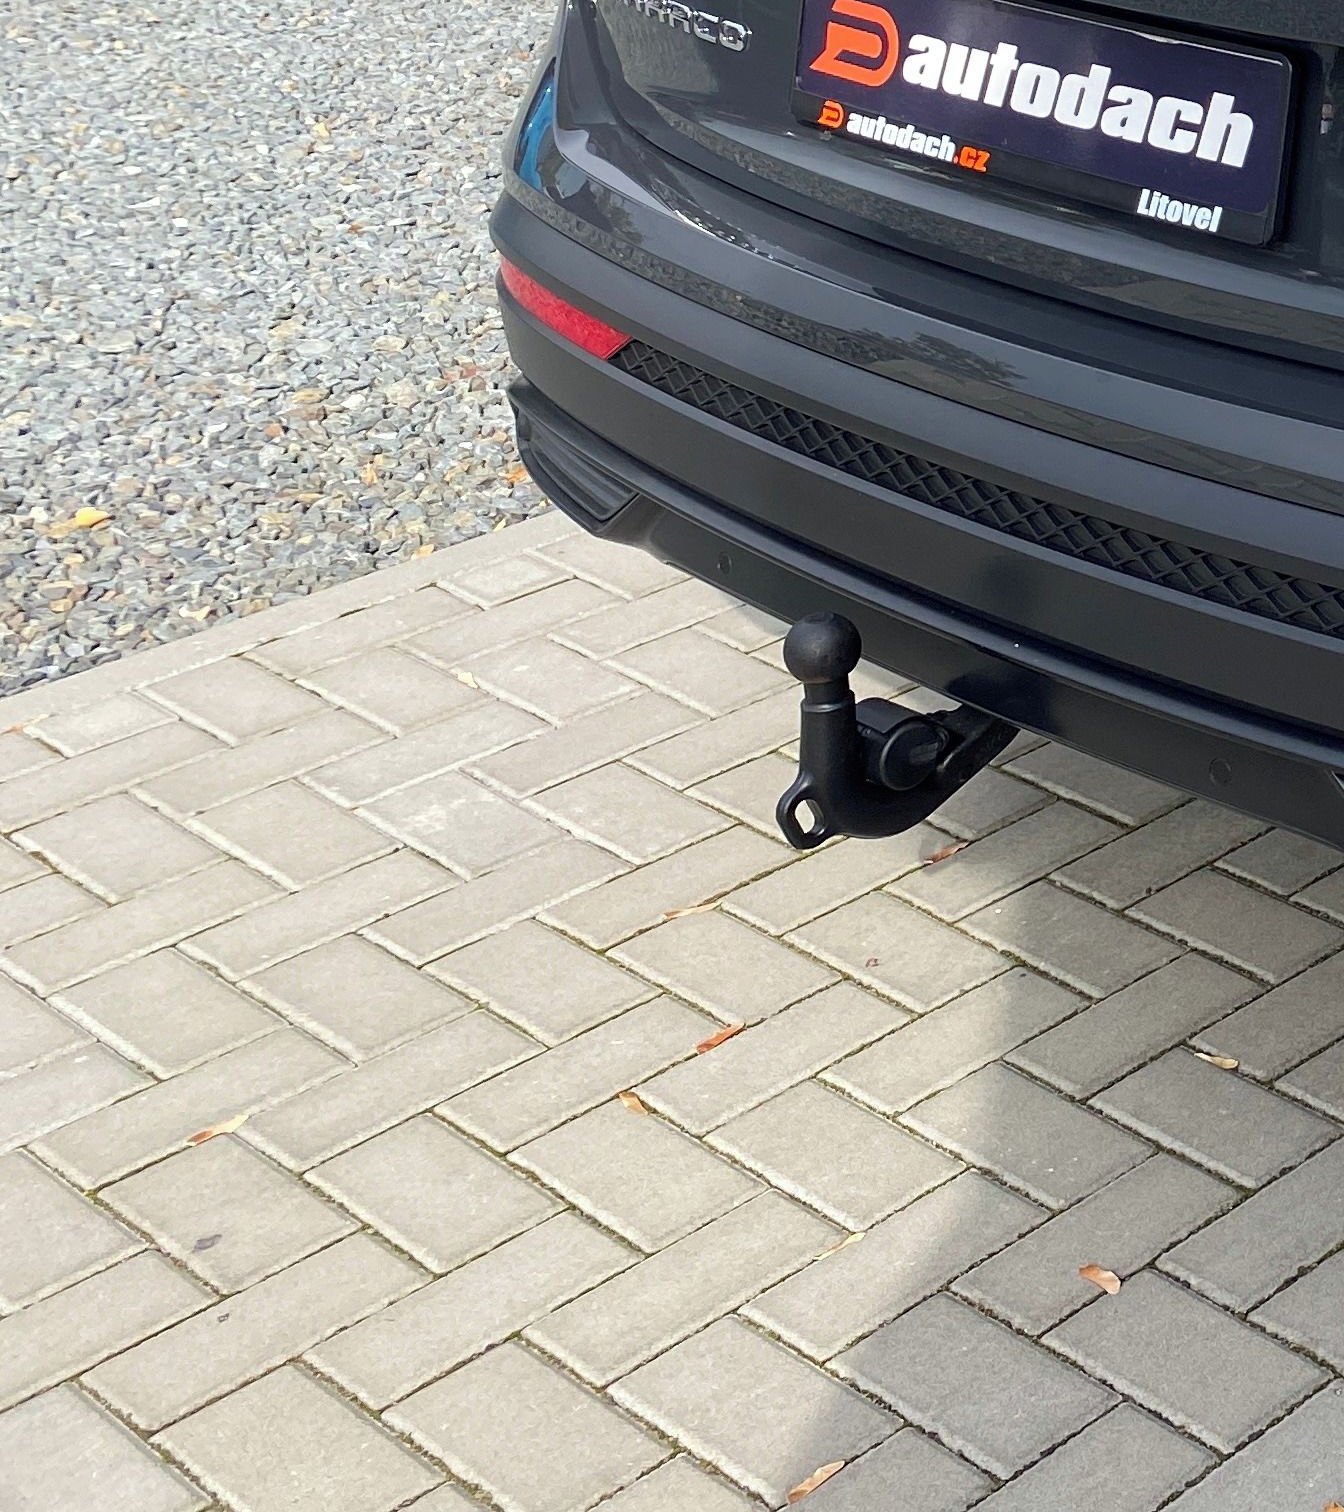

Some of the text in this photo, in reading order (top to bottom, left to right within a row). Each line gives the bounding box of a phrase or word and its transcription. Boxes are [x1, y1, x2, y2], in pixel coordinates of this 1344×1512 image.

[903, 34, 1254, 168] autodach
[847, 112, 990, 173] autodach.cz
[1137, 188, 1223, 233] Litovel
